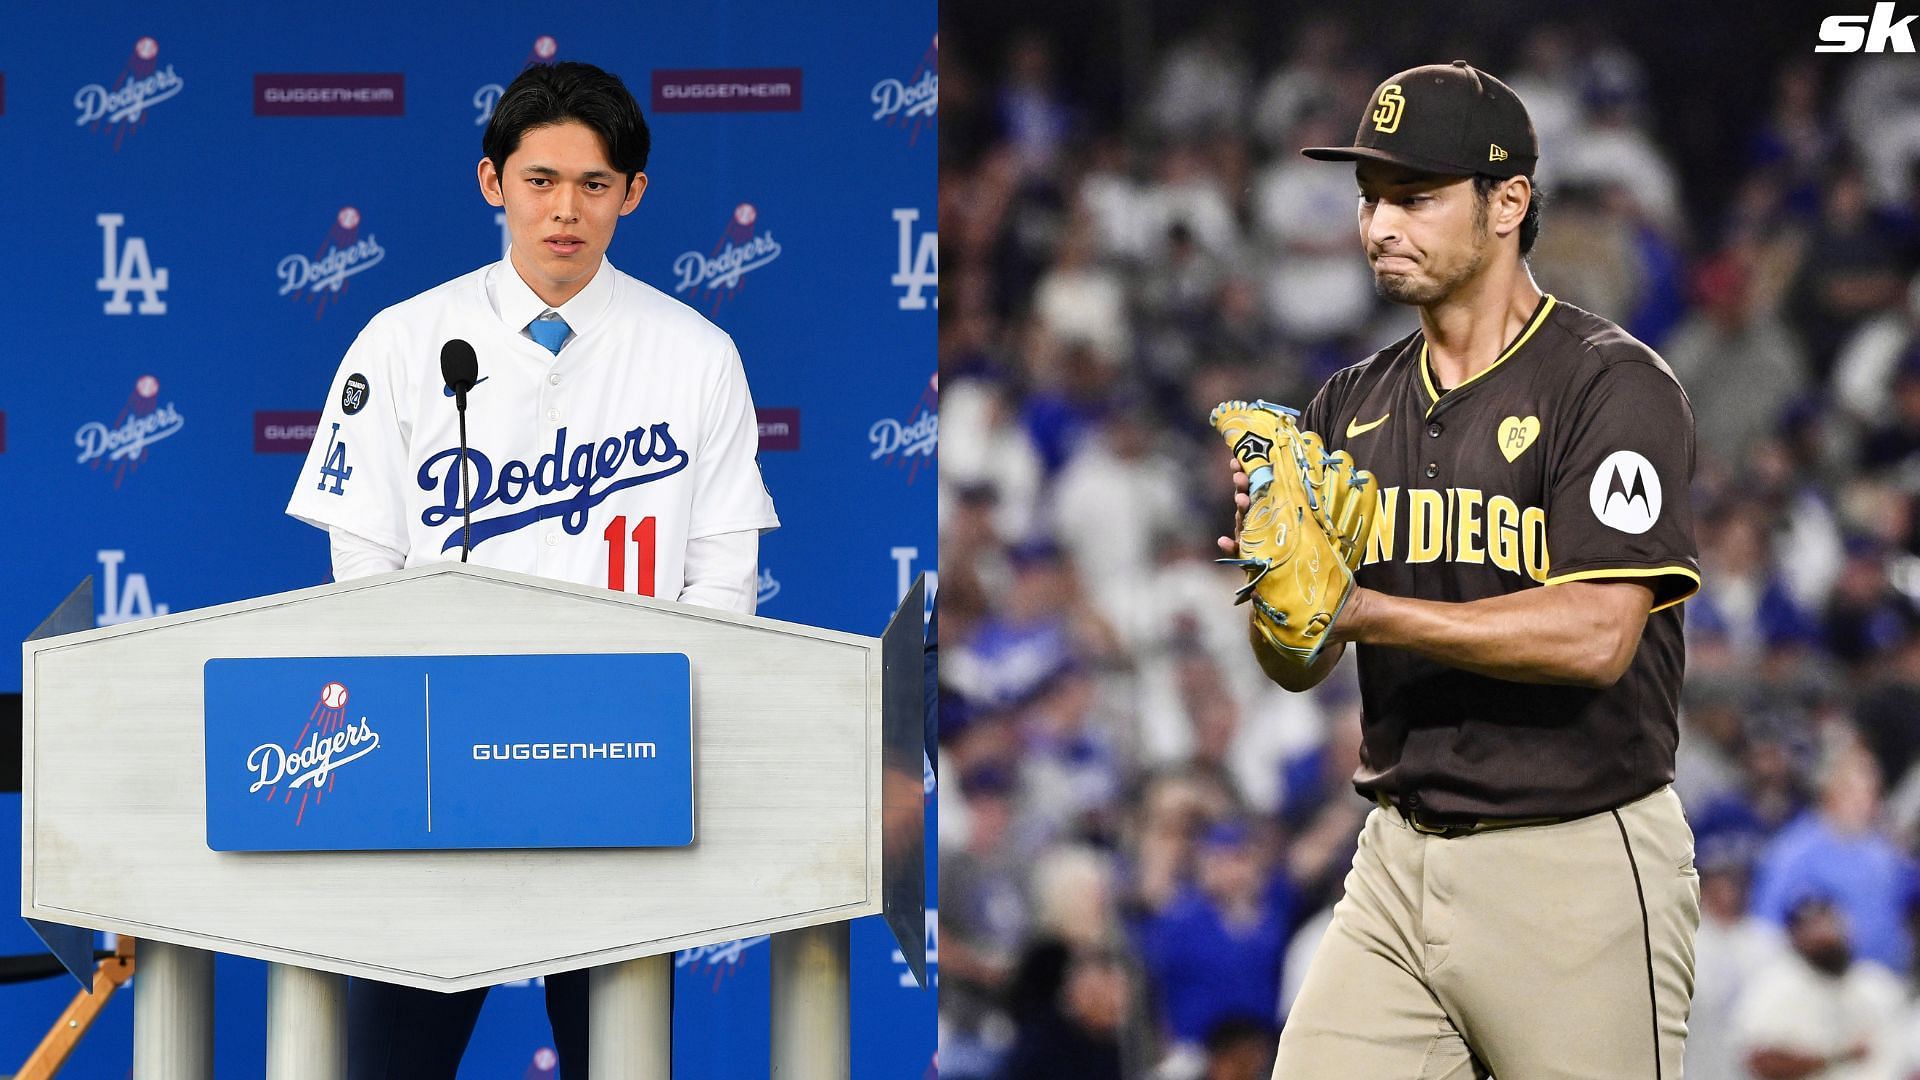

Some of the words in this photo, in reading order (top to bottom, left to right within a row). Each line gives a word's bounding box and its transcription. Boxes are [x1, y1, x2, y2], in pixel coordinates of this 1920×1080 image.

[74, 65, 183, 126] Dodgers
[264, 87, 394, 103] GUGGENHEIM
[661, 82, 791, 99] GUGGENHEIM
[871, 70, 938, 120] Dodg
[1372, 84, 1406, 134] SD
[96, 213, 168, 315] LA
[277, 234, 385, 295] Dodgers
[673, 230, 782, 293] Dodgers
[343, 387, 362, 409] 34
[75, 402, 184, 464] Dodgers
[317, 422, 353, 496] LA
[869, 411, 938, 460] Dodg
[1506, 427, 1527, 449] PS
[417, 422, 688, 553] Dodgers
[604, 515, 656, 598] 11
[247, 716, 379, 793] Dodgers
[472, 742, 657, 760] GUGGENHEIM
